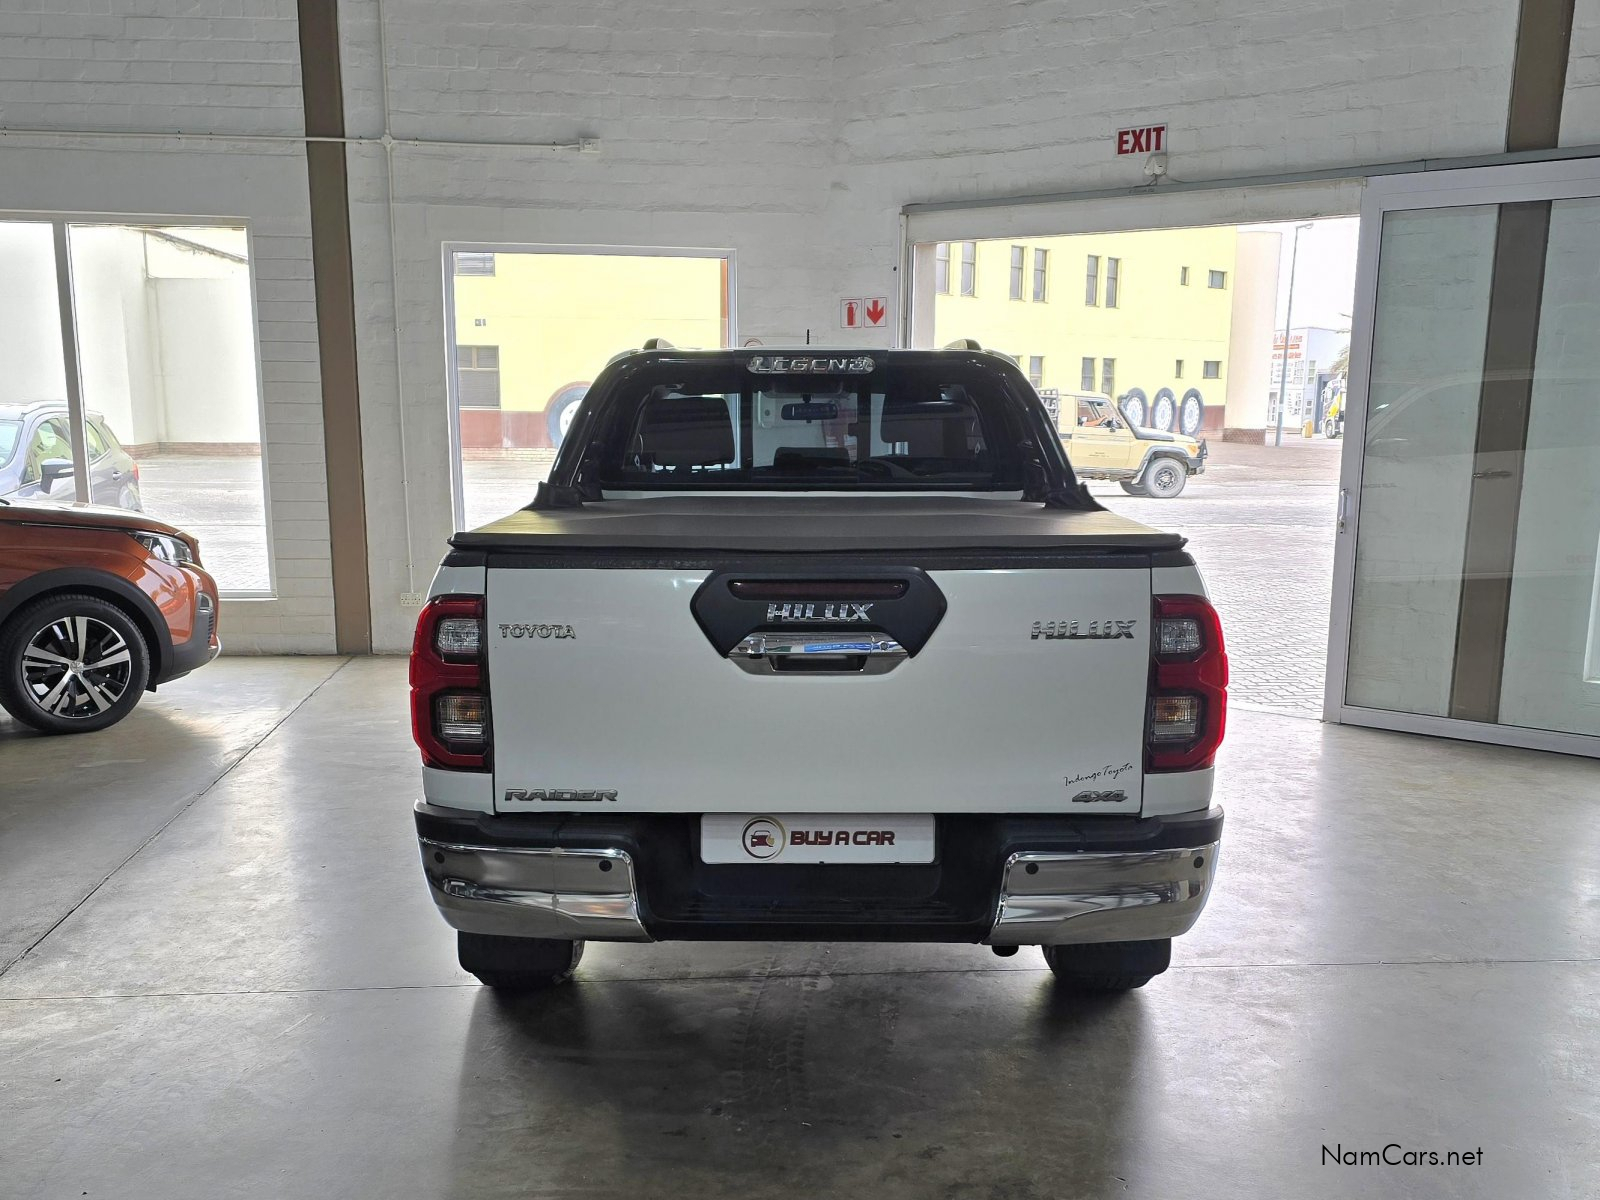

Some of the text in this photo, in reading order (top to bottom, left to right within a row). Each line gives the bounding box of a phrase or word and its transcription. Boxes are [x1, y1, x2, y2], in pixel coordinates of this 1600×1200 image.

[1117, 126, 1165, 155] EXIT
[766, 603, 874, 622] HILUX
[498, 624, 576, 639] TOYOTA
[1031, 620, 1137, 640] HILUX
[1102, 762, 1133, 780] Toyota
[504, 788, 618, 802] RAIDER
[790, 830, 896, 846] BUY A CAR
